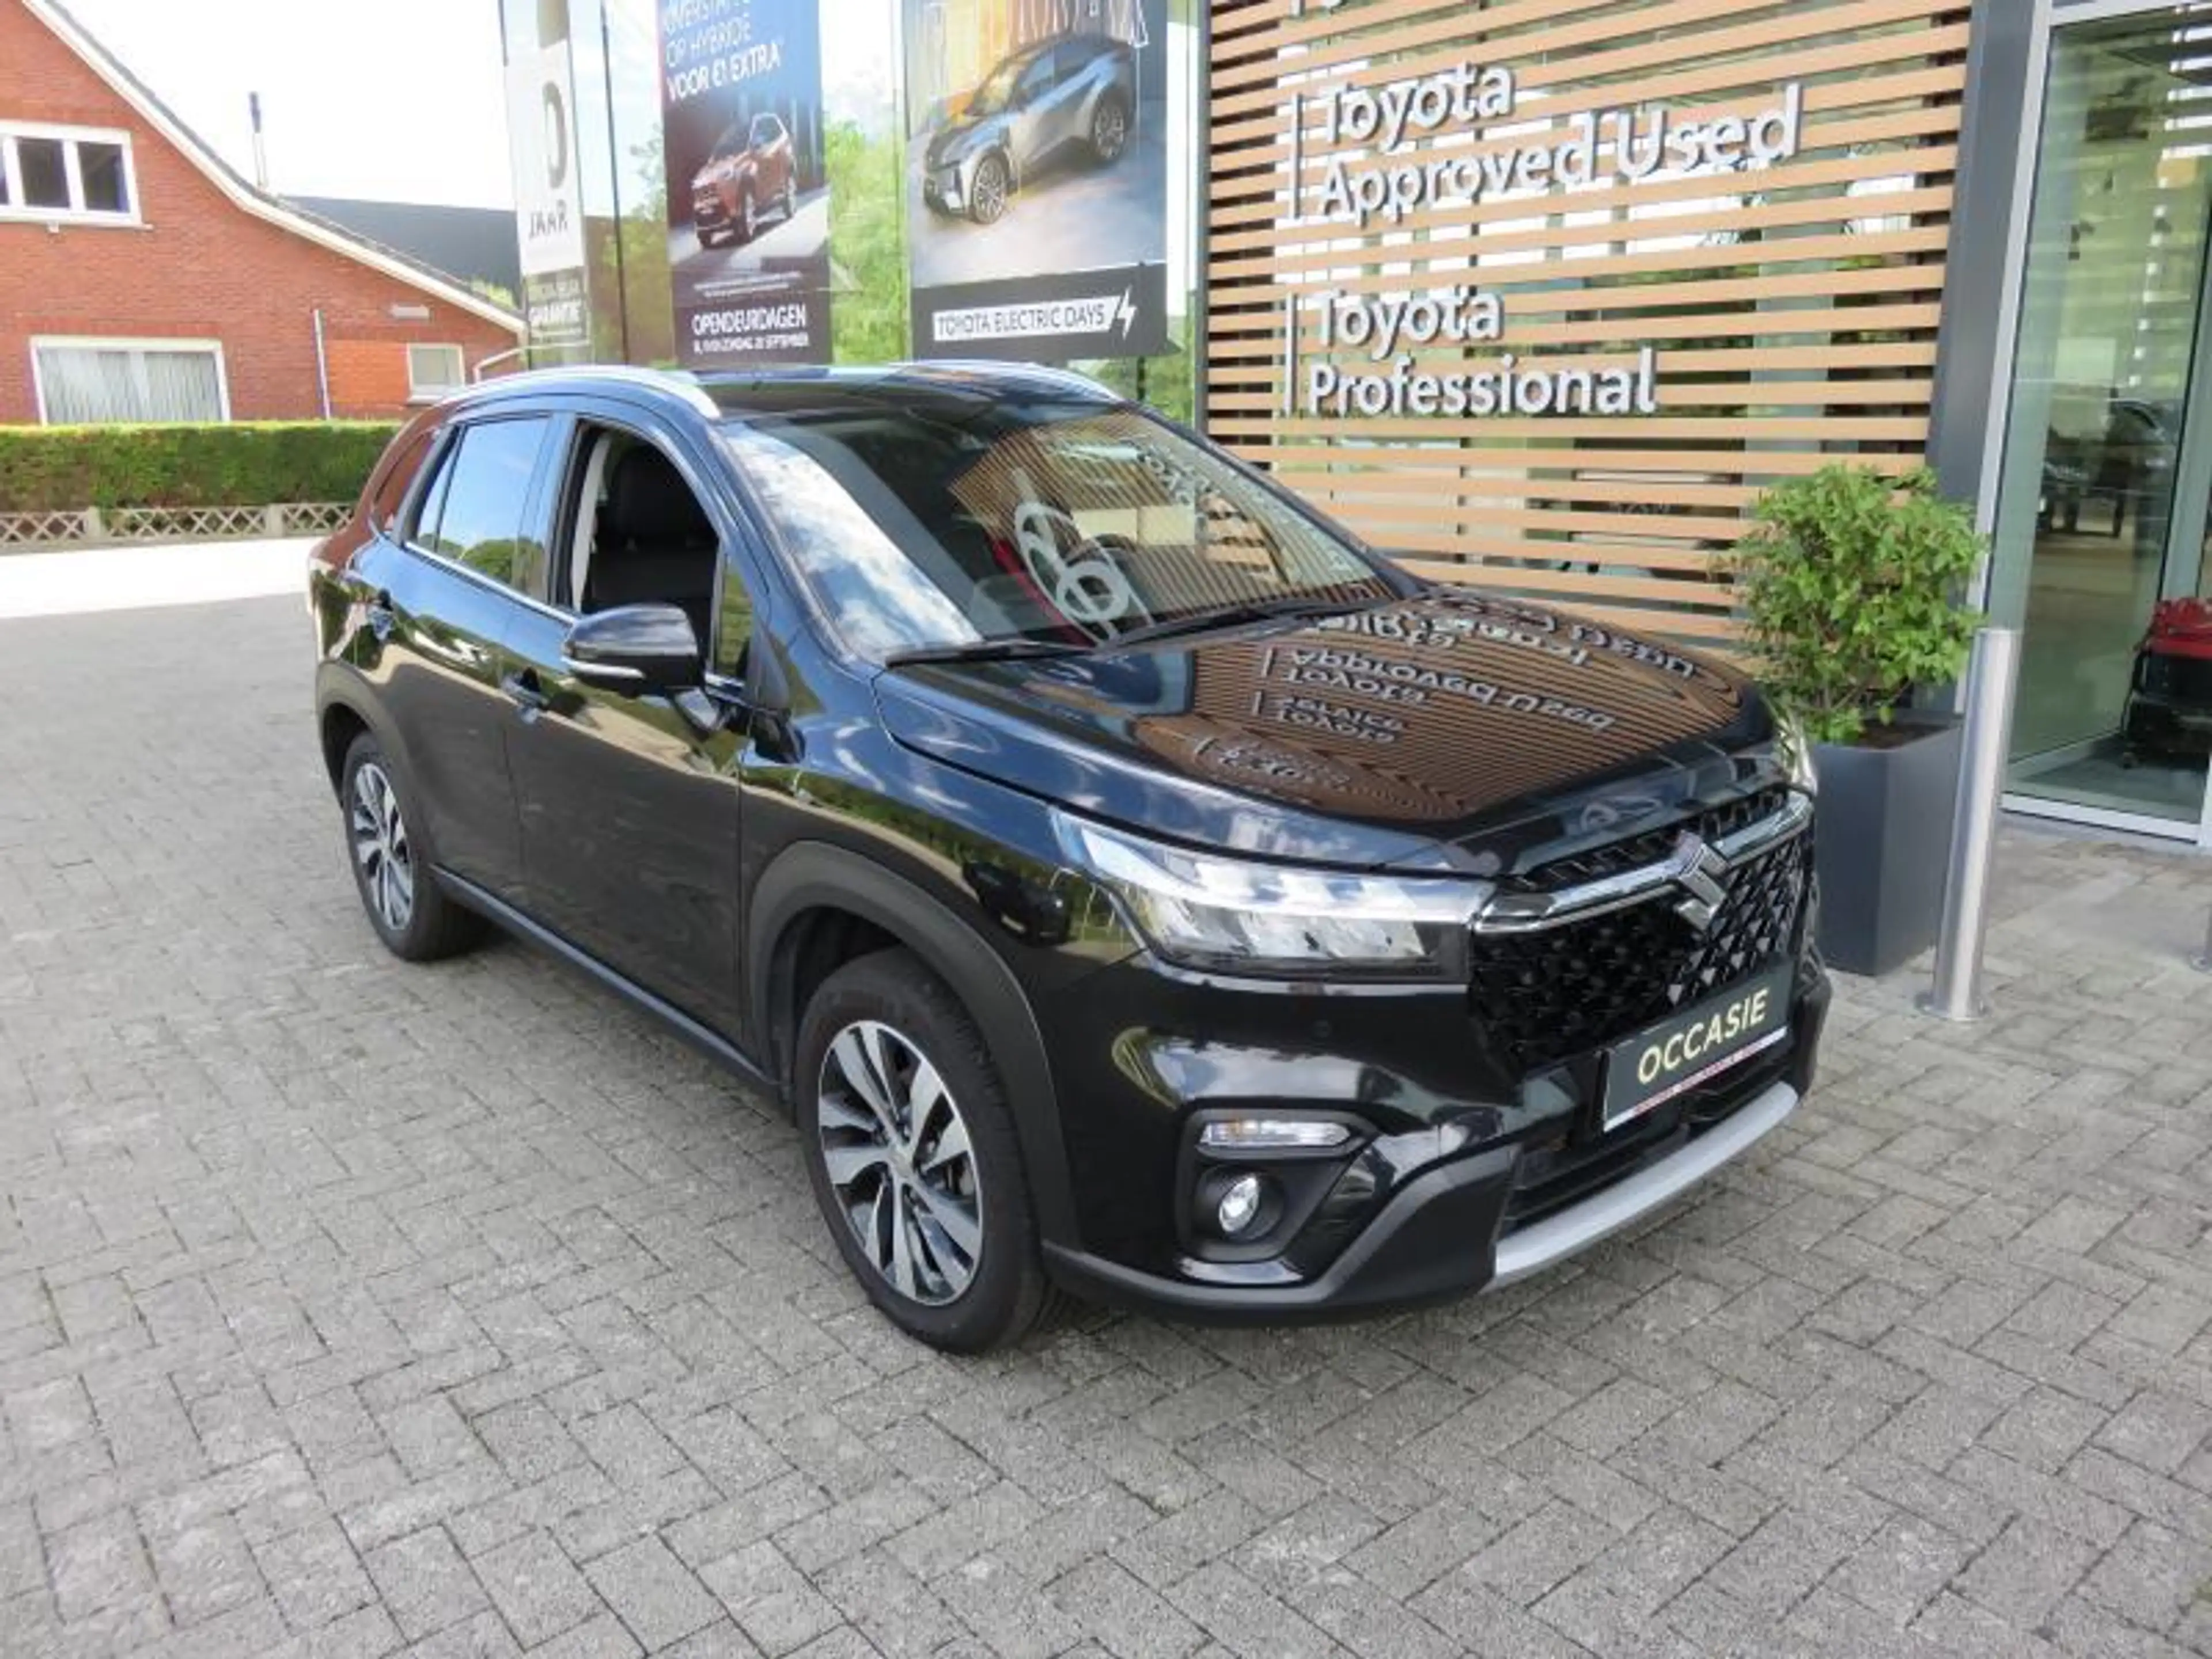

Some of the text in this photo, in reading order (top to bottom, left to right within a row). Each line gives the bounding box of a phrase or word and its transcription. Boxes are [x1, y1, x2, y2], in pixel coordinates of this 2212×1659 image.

[690, 12, 751, 60] HYBRIDE
[666, 65, 709, 103] VOOR
[1323, 60, 1515, 152] Toyota
[1322, 81, 1802, 227] Approved Used
[692, 302, 806, 335] OPENDEURDAGEN
[938, 302, 1105, 336] TOYOTA ELECTRIC DAYS
[1317, 286, 1505, 359] Toyota
[1308, 346, 1656, 415] Professional
[1637, 988, 1769, 1084] OCCASIE
